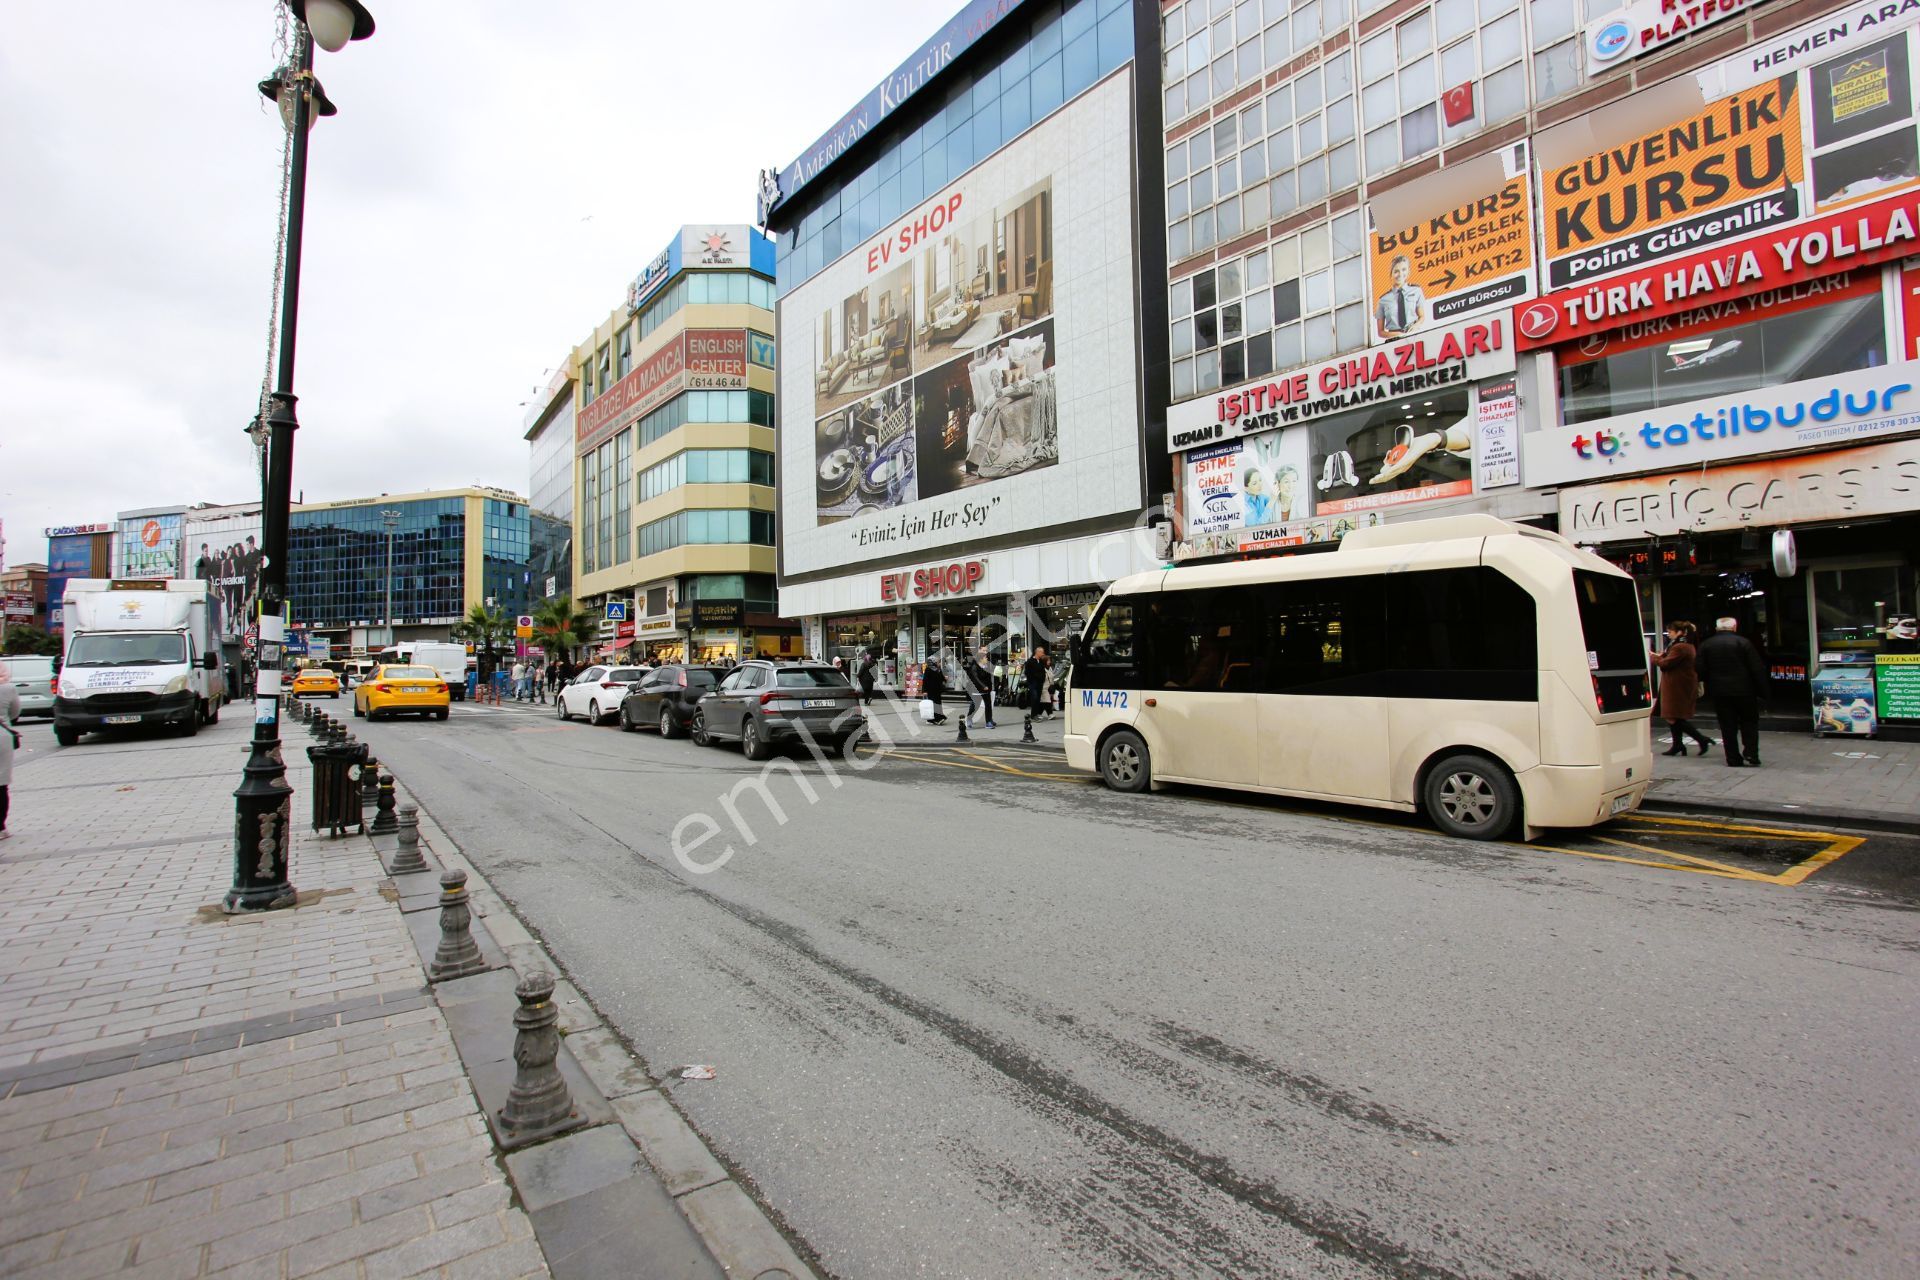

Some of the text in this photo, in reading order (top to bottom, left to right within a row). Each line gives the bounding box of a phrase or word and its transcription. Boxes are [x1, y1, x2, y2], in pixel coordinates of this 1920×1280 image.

[1752, 23, 1847, 73] HEMEN
[1836, 71, 1881, 93] KIRALIK
[790, 111, 868, 195] AMERİKAN
[880, 41, 952, 118] KÜLTÜR
[1554, 91, 1779, 196] GÜVENLİK
[1555, 132, 1786, 250] KURSU
[1430, 183, 1521, 236] KURS
[867, 192, 963, 274] EV SHOP
[1414, 210, 1524, 259] SİZİ MESLEK
[1569, 199, 1784, 277] Point Güvenlik
[1418, 229, 1521, 272] SAHİBİ YAPAR!
[1465, 248, 1523, 278] KAT:2
[1564, 203, 1920, 327] TÜRK HAVA YOLLA
[1438, 285, 1512, 314] KAYIT BÜROSU
[1679, 300, 1740, 328] HAVA
[690, 338, 743, 354] ENGLISH
[691, 359, 742, 374] CENTER
[696, 378, 742, 388] 614 46 44
[1173, 427, 1213, 447] UZMAN
[1243, 409, 1279, 431] SATIŞ
[1282, 404, 1298, 421] VE
[1302, 384, 1387, 417] UYGULAMA
[1390, 360, 1467, 396] MERKEZİ
[1639, 383, 1912, 449] tatilbudur
[1485, 425, 1505, 437] SGK
[1858, 423, 1879, 432] 0212
[1880, 420, 1896, 429] 578
[1206, 500, 1228, 513] SGK
[900, 514, 925, 540] İçin
[931, 509, 958, 531] Her
[1203, 523, 1230, 534] VARDIR
[1252, 527, 1288, 541] UZMAN
[880, 560, 985, 601] EV SHOP
[1082, 690, 1129, 710] M 4472
